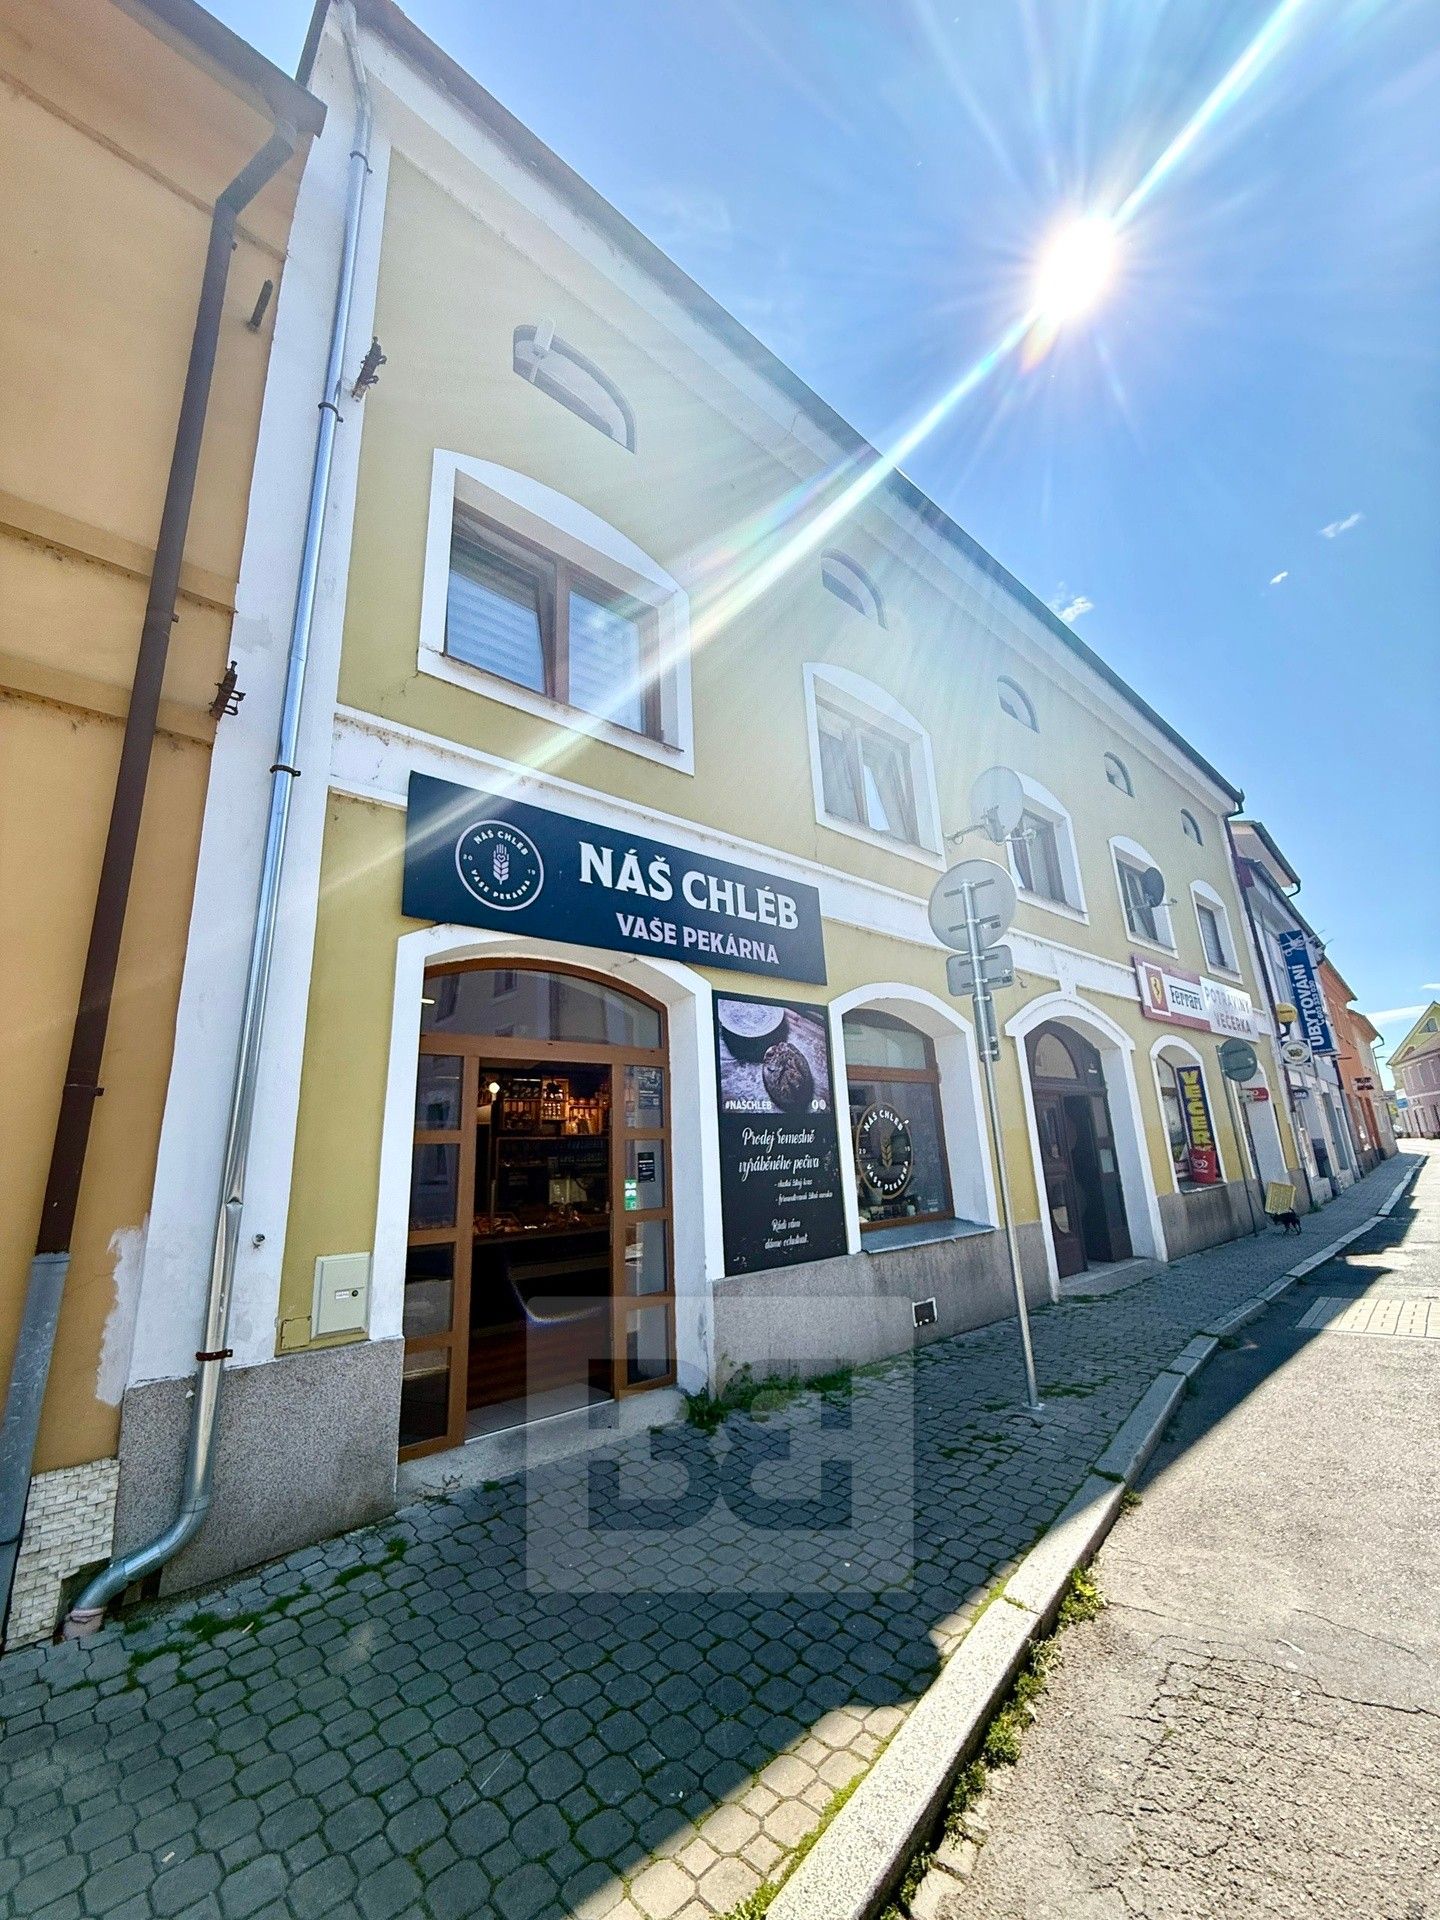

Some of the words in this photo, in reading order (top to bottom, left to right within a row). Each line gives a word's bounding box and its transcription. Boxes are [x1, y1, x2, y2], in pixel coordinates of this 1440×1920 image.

[579, 841, 673, 902] NÁŠ
[682, 871, 799, 929] CHLÉB
[615, 912, 678, 945] VAŠE
[682, 930, 780, 965] PEKÁRNA
[1169, 984, 1203, 1011] Ferrari
[1288, 963, 1325, 1047] UBYTOVÁNÍ
[742, 1127, 775, 1153] Prodej
[792, 1154, 819, 1174] pečiva
